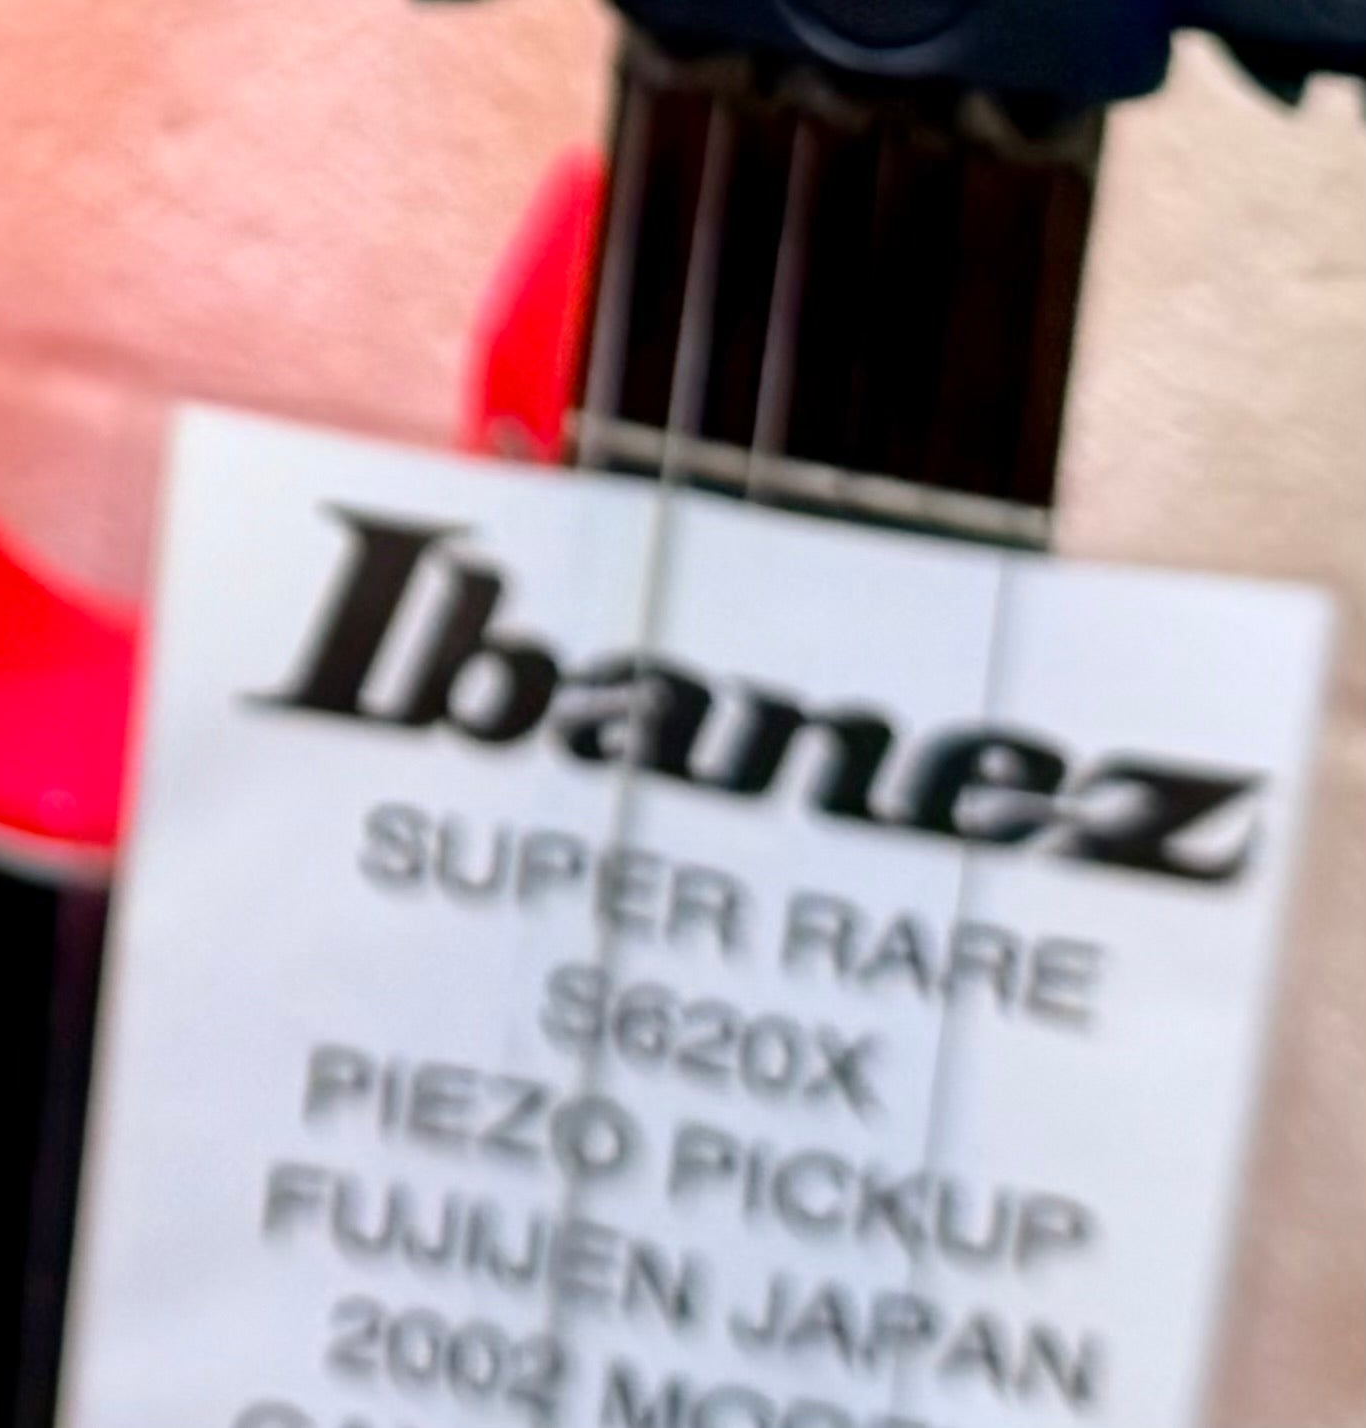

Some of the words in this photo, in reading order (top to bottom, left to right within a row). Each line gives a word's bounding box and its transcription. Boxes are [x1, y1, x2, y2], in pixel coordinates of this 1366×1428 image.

[241, 499, 1270, 889] Ibanez
[358, 799, 750, 952] SUPER
[780, 889, 1106, 1029] RARE
[538, 959, 883, 1116] S620X
[300, 1039, 640, 1181] PIEZO
[668, 1116, 1098, 1279] PICKUP
[323, 1289, 573, 1426] 2002
[728, 1269, 1103, 1406] JAPAN
